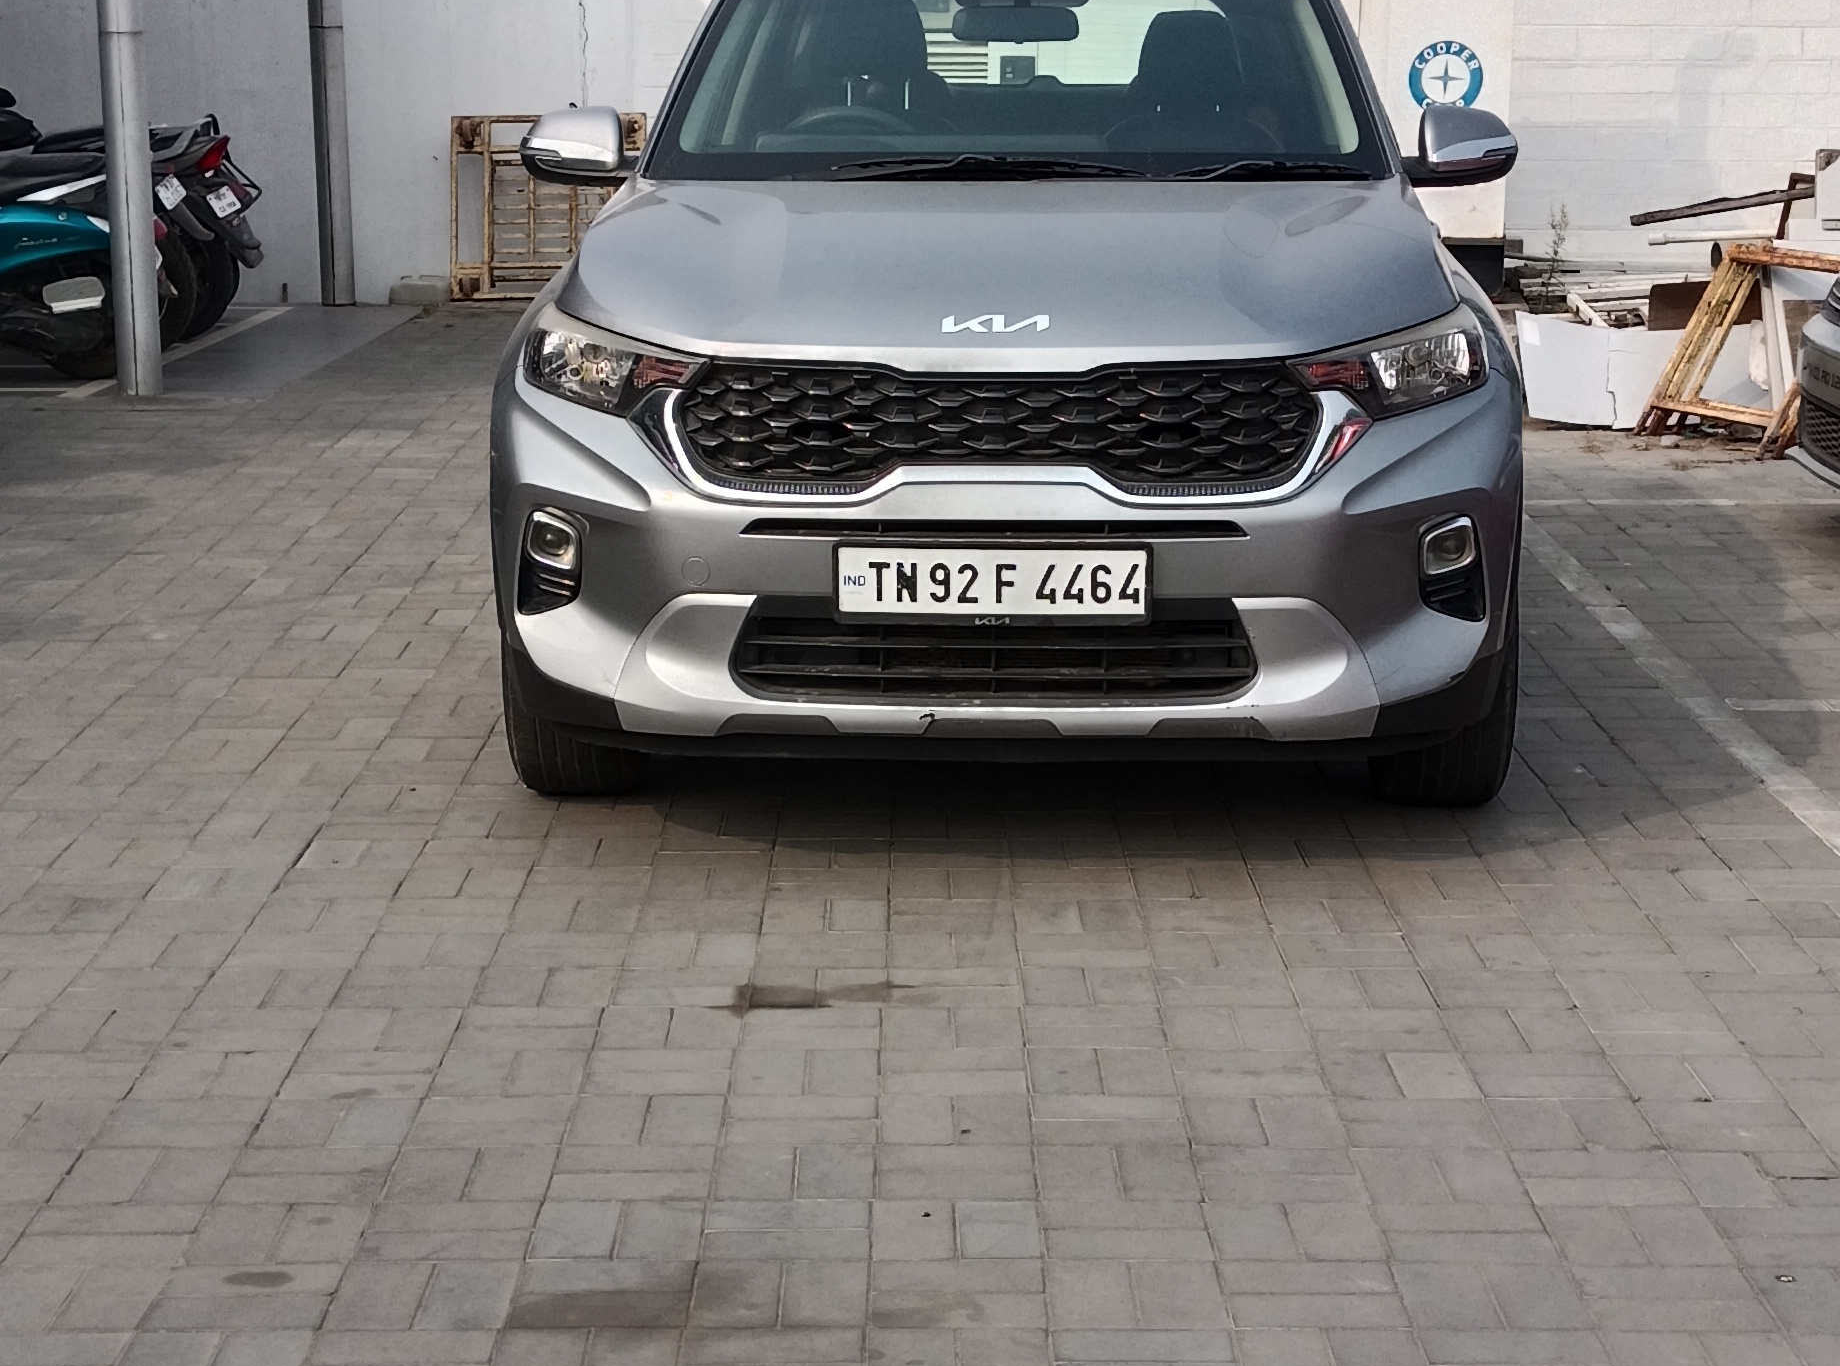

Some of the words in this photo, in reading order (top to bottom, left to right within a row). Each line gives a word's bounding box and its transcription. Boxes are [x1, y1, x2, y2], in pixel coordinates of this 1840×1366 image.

[1414, 42, 1480, 71] COOPER
[942, 315, 1050, 333] KIA
[843, 575, 866, 587] IND
[996, 564, 1017, 604] F
[1035, 563, 1140, 605] 4464
